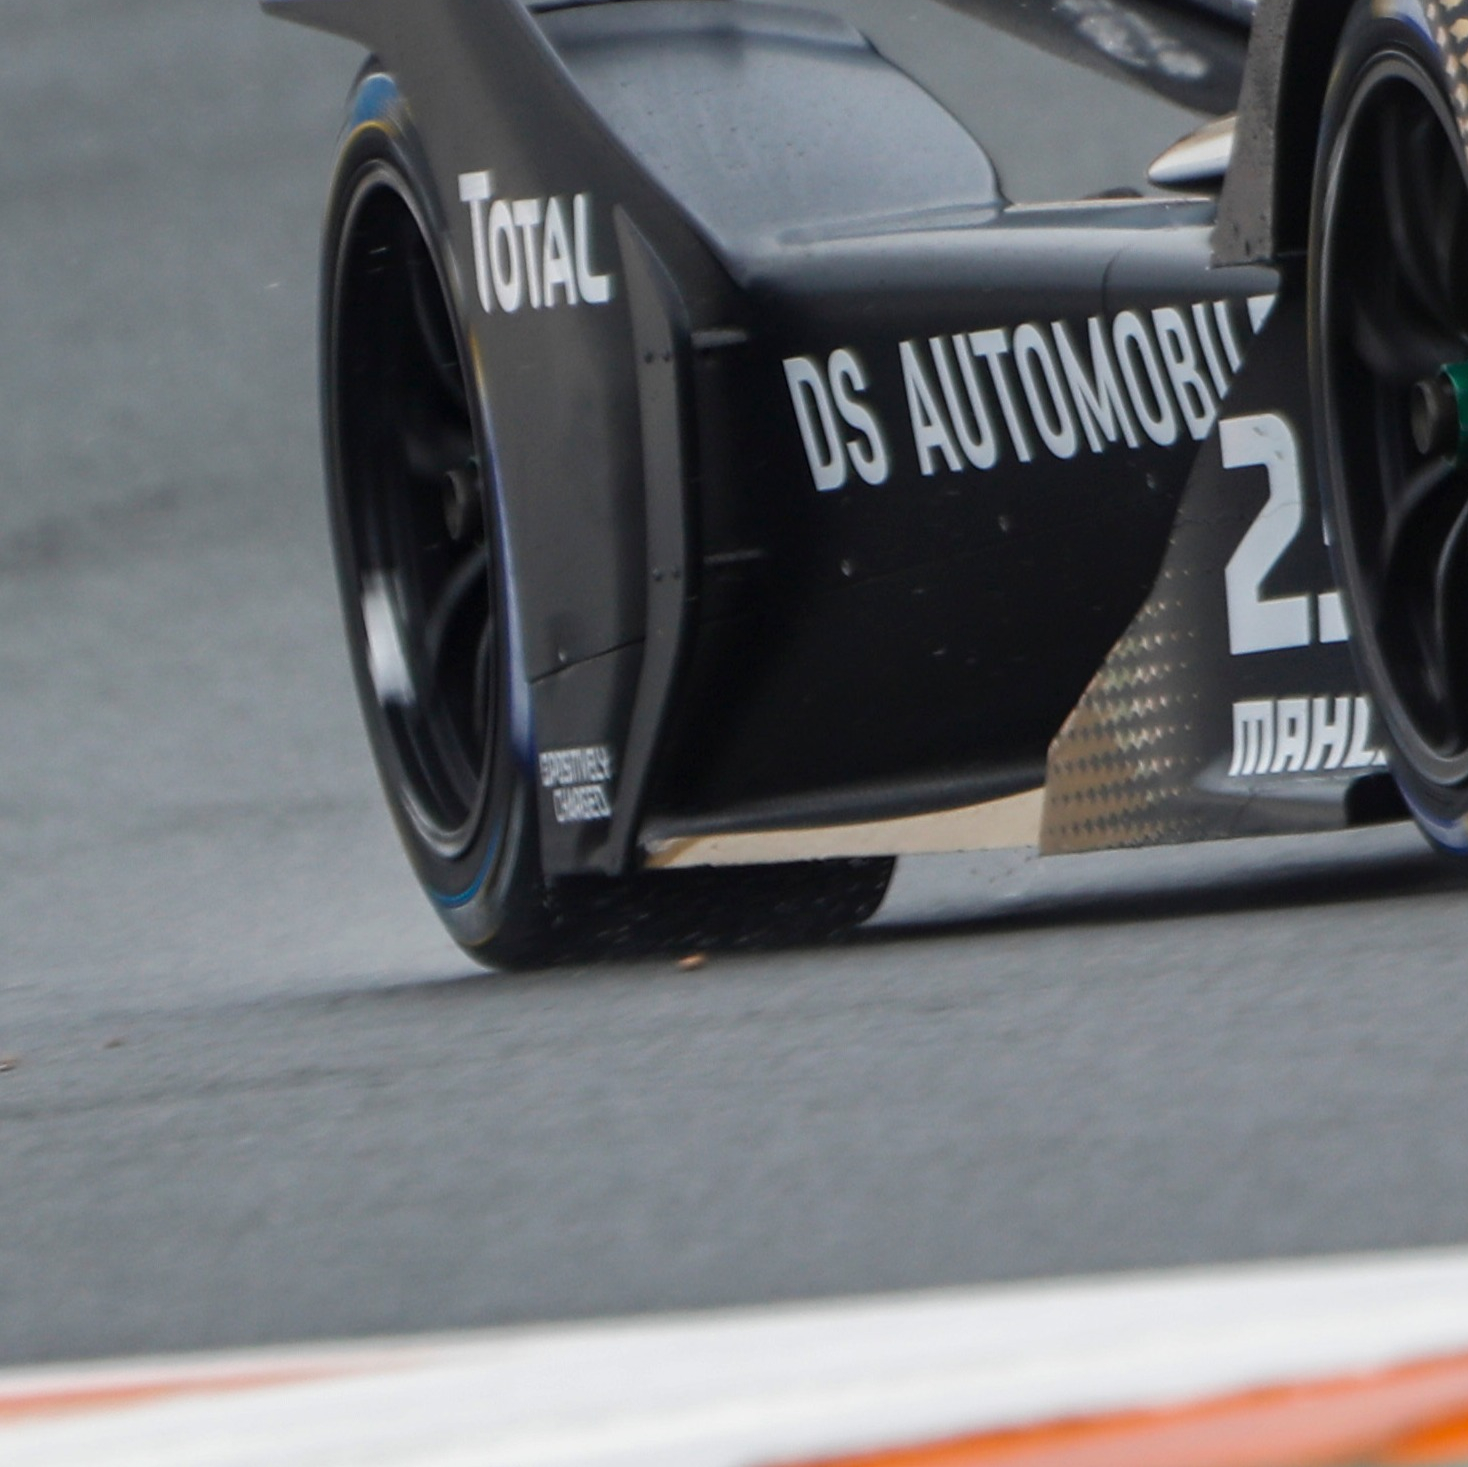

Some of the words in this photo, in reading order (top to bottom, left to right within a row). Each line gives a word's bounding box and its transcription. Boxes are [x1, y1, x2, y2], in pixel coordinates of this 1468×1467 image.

[458, 171, 611, 314] TOTAL
[782, 347, 890, 493] DS
[899, 293, 1277, 476] AUTOMOBI
[1218, 413, 1350, 656] 2
[1228, 696, 1388, 777] MAHL
